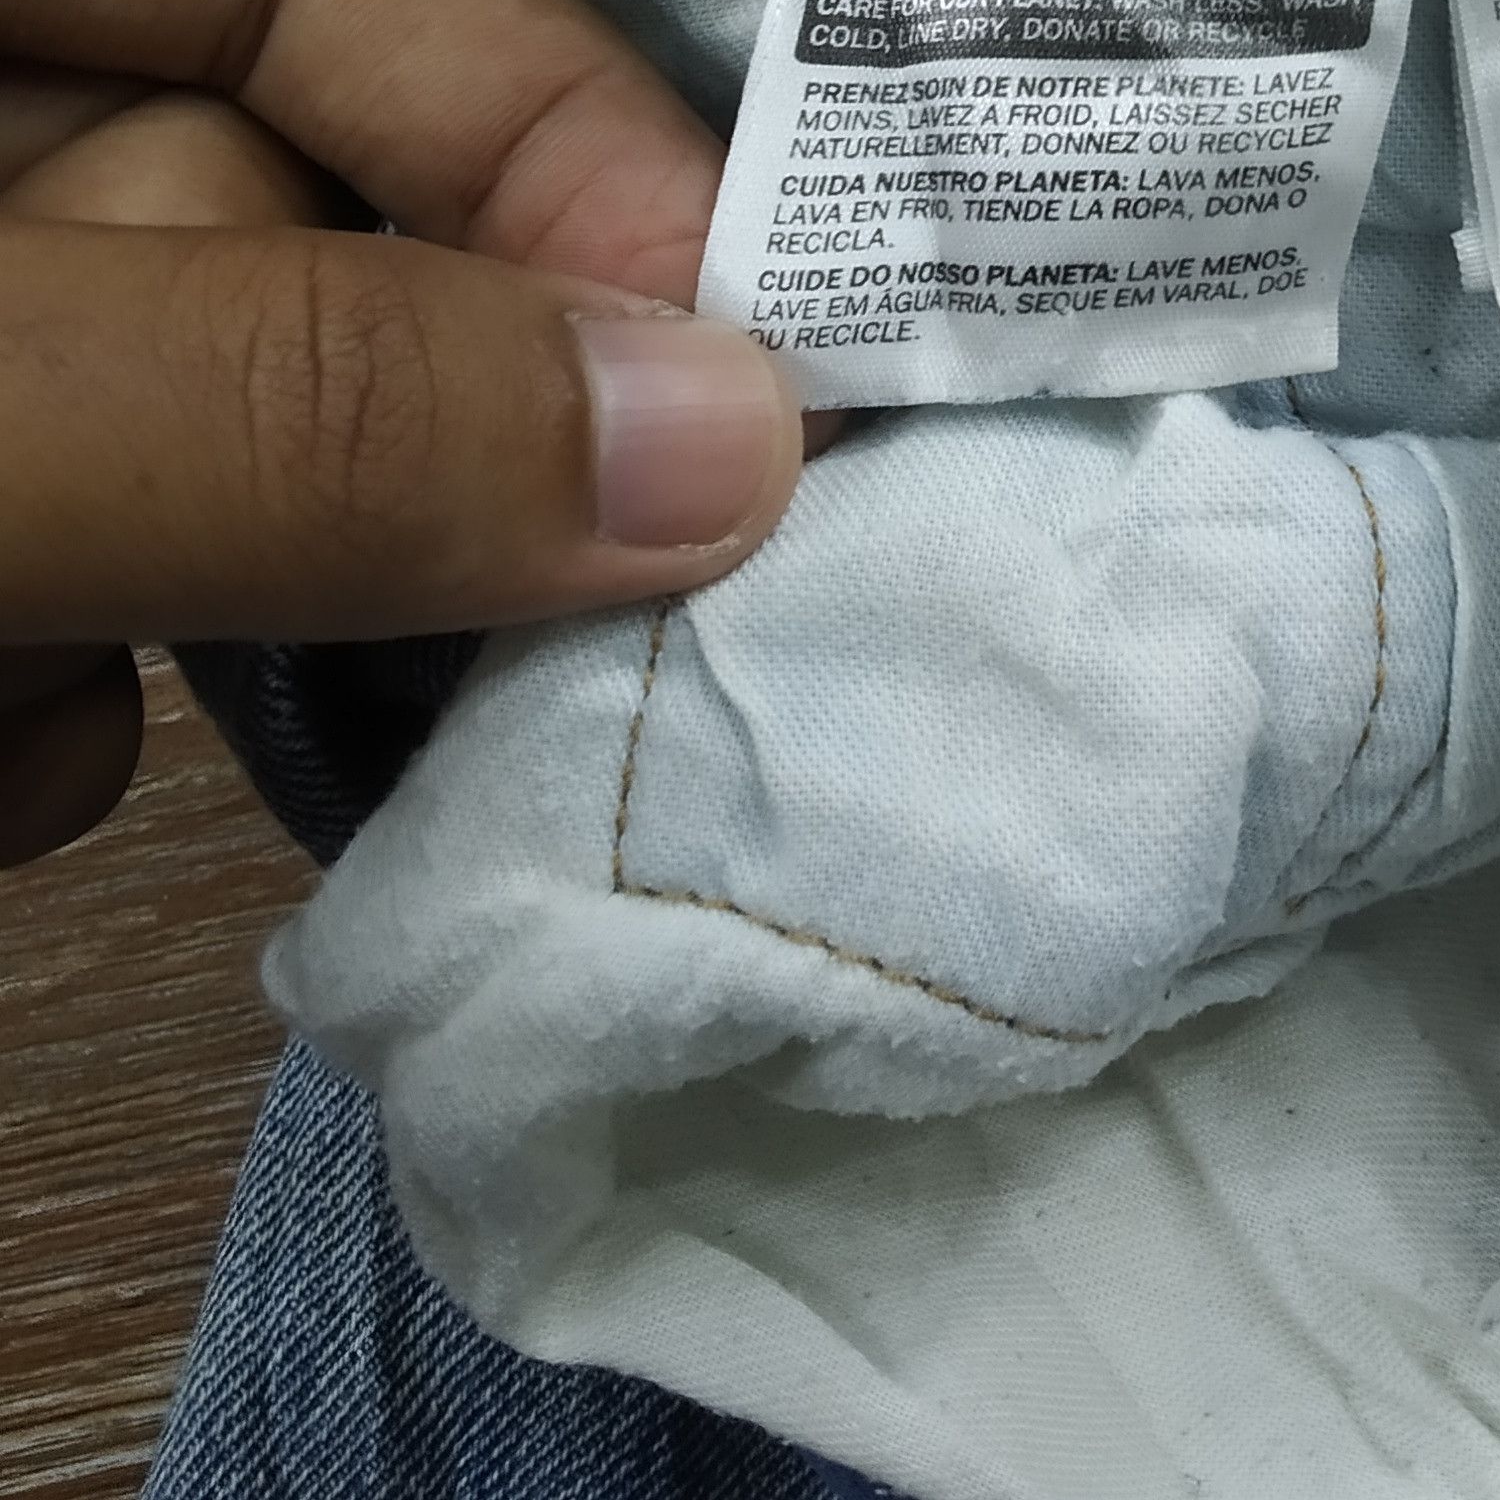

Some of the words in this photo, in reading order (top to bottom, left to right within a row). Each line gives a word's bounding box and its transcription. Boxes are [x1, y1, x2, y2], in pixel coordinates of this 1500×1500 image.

[808, 23, 891, 54] COLD,
[897, 21, 945, 50] LINE
[1023, 17, 1134, 43] DONATE
[1143, 17, 1181, 43] OR
[803, 80, 909, 105] PRENEZ
[911, 76, 967, 102] SOIN
[973, 76, 1012, 99] DE
[1016, 75, 1111, 99] NOTRE
[1252, 66, 1335, 96] LAVEZ
[796, 108, 899, 133] MOINS,
[906, 104, 973, 131] LAVEZ
[979, 104, 999, 127] A
[1007, 104, 1099, 130] FROID,
[1108, 102, 1228, 127] LAISSEZ
[1235, 93, 1343, 125] SECHER
[789, 132, 1010, 160] NATURELLEMENT,
[1020, 131, 1141, 156] DONNEZ
[1147, 132, 1189, 155] OU
[1197, 122, 1335, 155] RECYCLEZ
[780, 173, 866, 198] CUIDA
[873, 171, 989, 194] NUESTRO
[994, 170, 1130, 194] PLANETA:
[1137, 167, 1207, 192] LAVA
[772, 202, 842, 227] LAVA
[850, 200, 891, 224] EN
[963, 198, 1063, 223] TIENDE
[1068, 198, 1104, 222] LA
[1111, 198, 1196, 223] ROPA,
[1203, 192, 1280, 219] DONA
[1286, 187, 1308, 210] O
[766, 227, 896, 256] RECICLA.
[757, 266, 845, 293] CUIDE
[848, 263, 892, 288] DO
[897, 261, 980, 288] NOSSO
[985, 262, 1120, 288] PLANETA:
[1125, 257, 1196, 283] LAVE
[752, 297, 820, 323] LAVE
[826, 293, 870, 318] EM
[874, 287, 949, 316] ÁGUA
[1014, 289, 1109, 318] SEQUE
[1113, 286, 1156, 310] EM
[1256, 265, 1309, 297] DOE
[794, 319, 921, 351] RECICLE.
